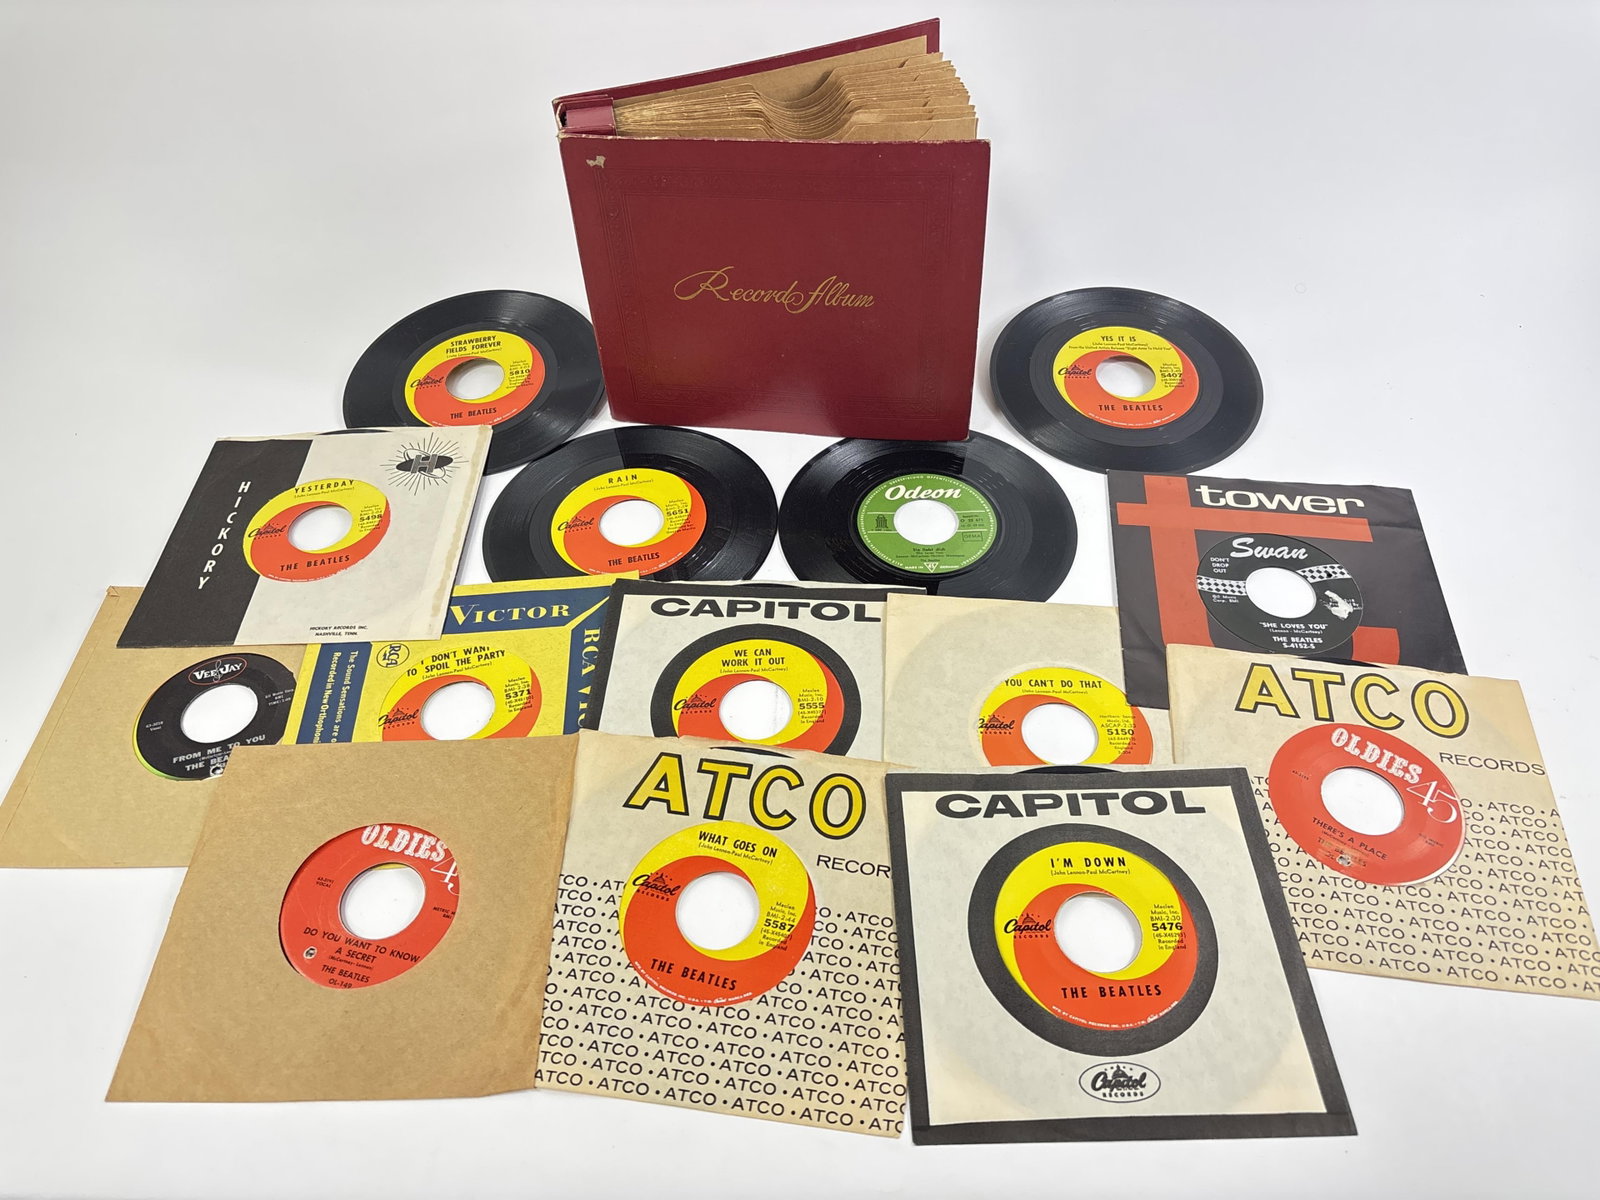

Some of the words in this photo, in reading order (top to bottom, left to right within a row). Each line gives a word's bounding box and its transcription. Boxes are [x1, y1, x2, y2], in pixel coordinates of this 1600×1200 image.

[674, 266, 798, 302] Record
[785, 275, 875, 314] Album
[446, 346, 467, 354] FIELDS
[471, 341, 501, 351] FOREVER
[450, 335, 497, 347] STRAWBERRY
[1057, 366, 1092, 377] Capitol
[450, 412, 463, 420] THE
[467, 407, 497, 417] BEATLES
[294, 480, 355, 494] YESTERDAY
[608, 474, 638, 484] RAIN
[885, 485, 961, 501] Odeon
[1195, 485, 1365, 515] tower
[360, 514, 383, 522] 5498
[666, 509, 689, 517] 5651
[199, 481, 251, 590] HICKORY
[1230, 537, 1308, 560] Swan
[280, 563, 299, 572] THE
[306, 555, 351, 568] BEATLES
[608, 559, 623, 567] THE
[628, 552, 660, 564] BEATLES
[450, 603, 571, 626] VICTOR
[651, 598, 881, 622] CAPITOL
[349, 651, 359, 663] The
[431, 651, 457, 663] DON'T
[582, 627, 601, 677] RCA
[754, 648, 772, 656] CAN
[328, 652, 342, 683] Recorded
[407, 668, 417, 677] TO
[425, 662, 449, 673] SPOIL
[456, 657, 471, 667] THE
[478, 650, 505, 662] PARTY
[722, 659, 748, 667] WORK
[755, 658, 762, 666] IT
[769, 657, 785, 665] OUT
[344, 664, 355, 685] Sound
[1004, 679, 1022, 687] YOU
[1029, 679, 1054, 687] CAN'T
[1061, 680, 1073, 688] DO
[1079, 680, 1102, 688] THAT
[322, 690, 333, 703] New
[505, 689, 531, 700] 5371
[1235, 662, 1469, 739] ATCO
[335, 686, 350, 723] Sensations
[674, 697, 717, 712] Capitol
[799, 702, 825, 710] 5555
[332, 725, 340, 737] are
[1107, 728, 1135, 736] 5150
[173, 752, 201, 764] FROM
[207, 746, 222, 755] ME
[246, 734, 266, 744] YOU
[185, 761, 205, 771] THE
[1439, 752, 1545, 776] RECORDS
[1331, 727, 1423, 784] OLDIES
[1407, 780, 1458, 824] 45
[622, 752, 867, 840] ATCO
[935, 790, 1206, 819] CAPITOL
[361, 824, 448, 862] OLDIES
[698, 830, 728, 846] WHAT
[733, 839, 757, 853] GOES
[762, 846, 778, 858] ON
[1312, 817, 1344, 839] THERE'S
[1348, 836, 1356, 844] A
[1359, 842, 1388, 860] PLACE
[1050, 858, 1073, 868] I'M
[1084, 857, 1126, 867] DOWN
[632, 874, 681, 896] Capitol
[1330, 891, 1379, 906] ATCO
[1395, 899, 1445, 915] ATCO
[1461, 907, 1511, 922] ATCO
[1527, 915, 1577, 930] ATCO
[764, 918, 795, 932] 5587
[1004, 919, 1052, 934] Capitol
[1151, 922, 1183, 932] 5476
[304, 927, 318, 936] DO
[322, 931, 342, 942] YOU
[344, 937, 372, 951] WANT
[374, 945, 387, 955] TO
[390, 949, 420, 963] KNOW
[553, 919, 601, 935] ATCO
[802, 951, 852, 968] ATCO
[335, 947, 342, 955] A
[346, 949, 377, 964] SECRET
[321, 964, 337, 974] THE
[338, 969, 370, 983] BEATLES
[650, 958, 675, 974] THE
[681, 966, 737, 991] BEATLES
[1061, 987, 1088, 999] THE
[1099, 984, 1162, 998] BEATLES
[576, 1003, 627, 1021] ATCO
[640, 1012, 692, 1030] ATCO
[705, 1021, 757, 1039] ATCO
[771, 1031, 823, 1049] ATCO
[837, 1041, 889, 1059] ATCO
[582, 1022, 634, 1040] ATCO
[647, 1031, 699, 1049] ATCO
[713, 1041, 765, 1059] ATCO
[779, 1050, 832, 1068] ATCO
[846, 1060, 899, 1078] ATCO
[1091, 1071, 1147, 1093] Capitol
